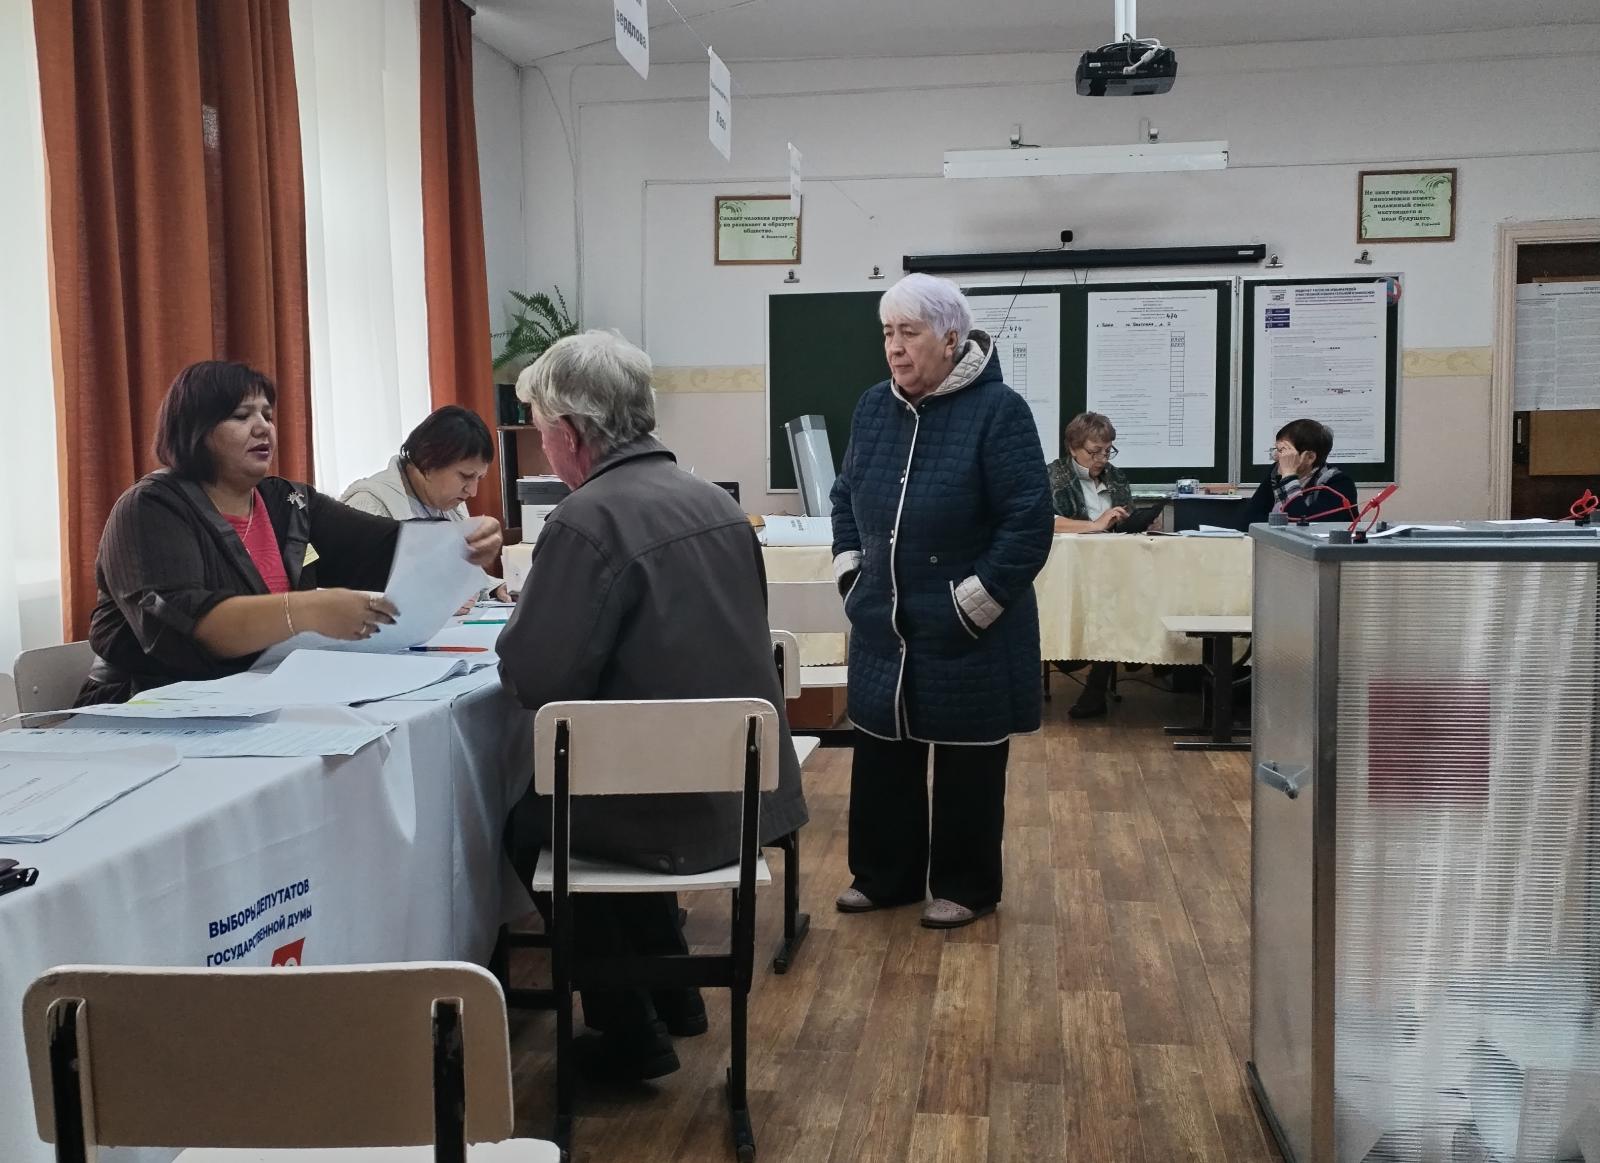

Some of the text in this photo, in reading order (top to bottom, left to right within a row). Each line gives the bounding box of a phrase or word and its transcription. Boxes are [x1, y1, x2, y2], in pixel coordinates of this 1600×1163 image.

[209, 879, 310, 939] ВЫБОРЫ ДЕПУТАТОВ
[287, 904, 312, 930] ДУМЫ
